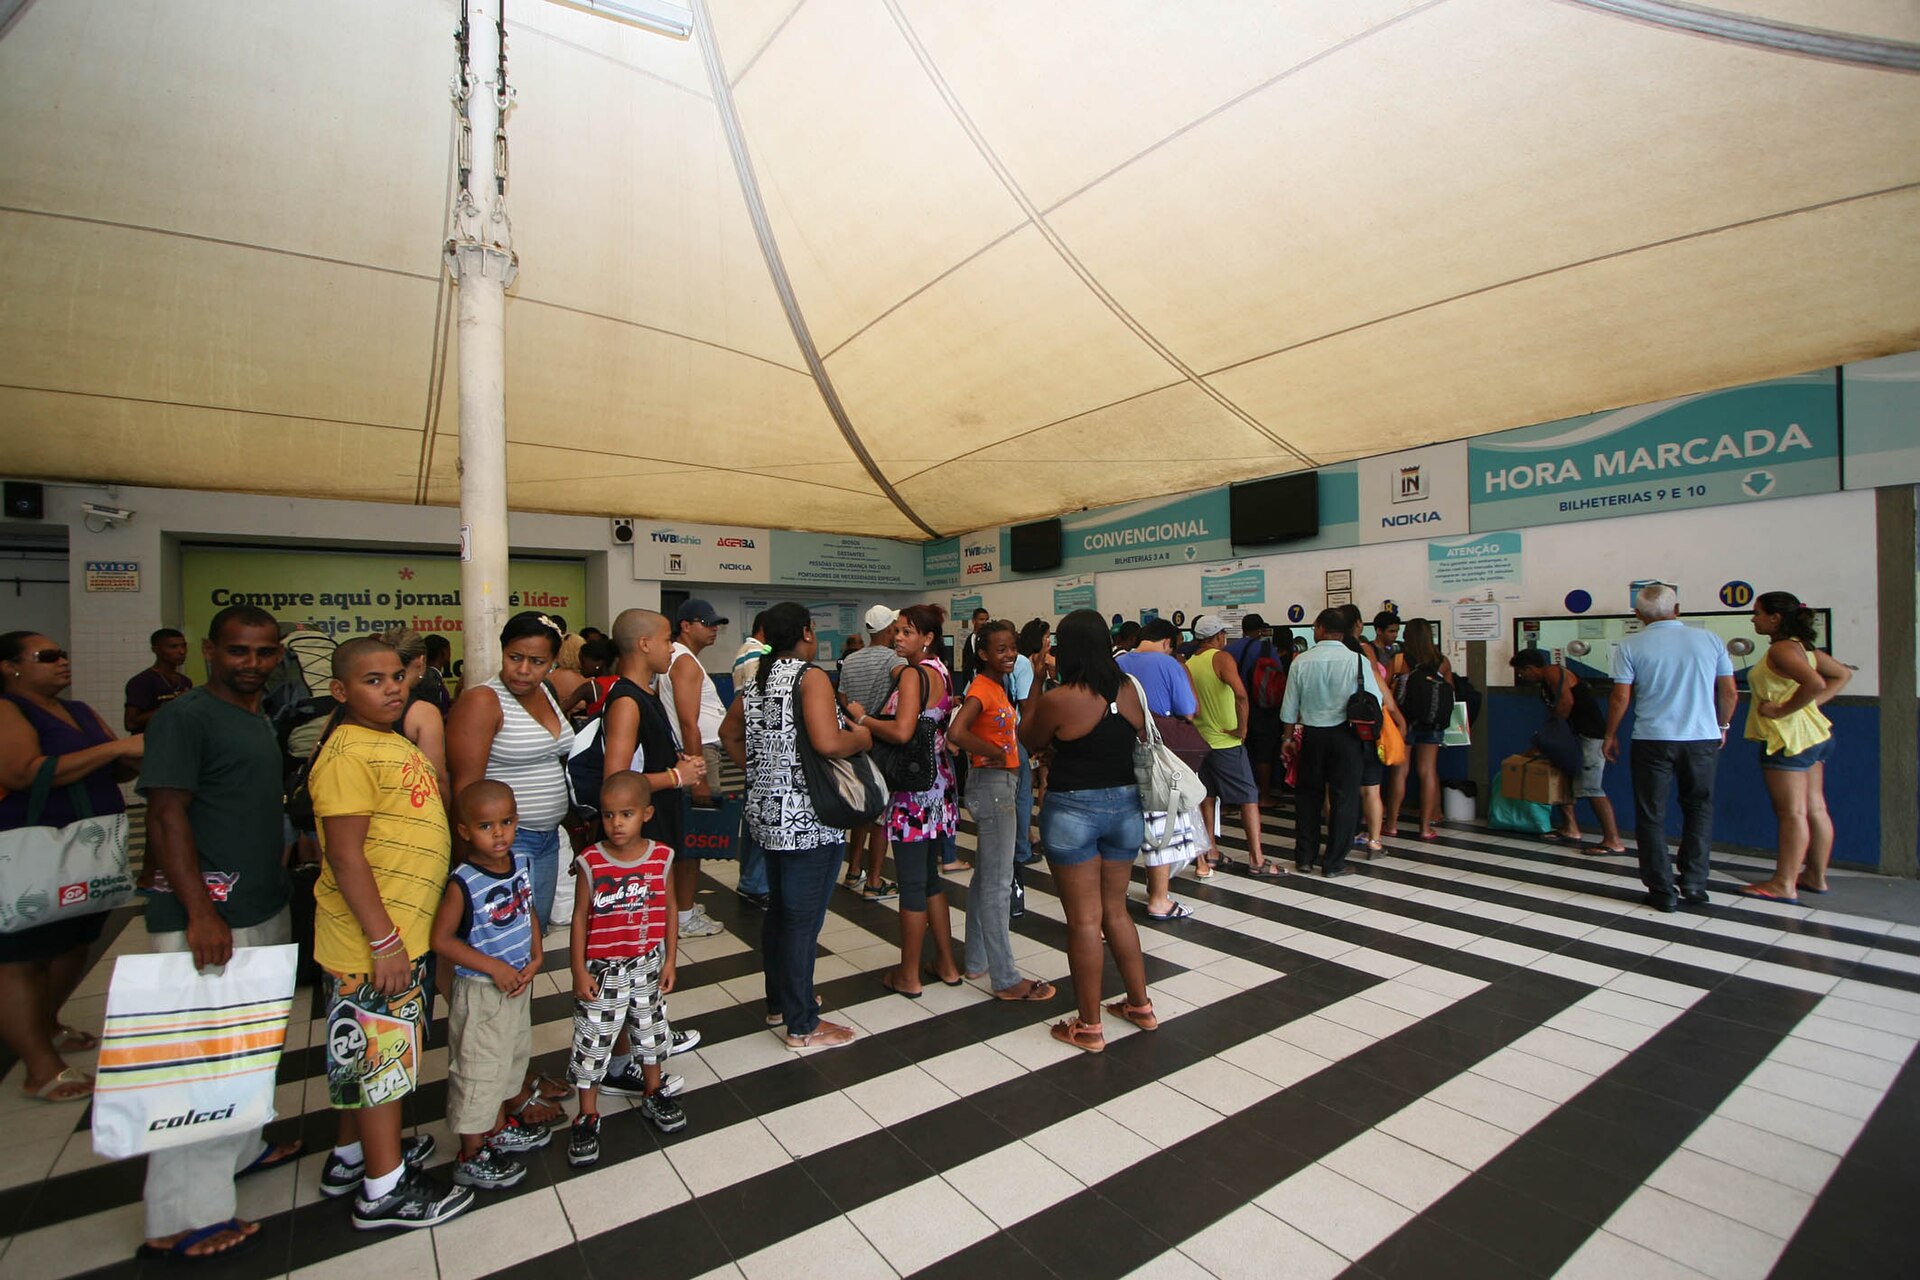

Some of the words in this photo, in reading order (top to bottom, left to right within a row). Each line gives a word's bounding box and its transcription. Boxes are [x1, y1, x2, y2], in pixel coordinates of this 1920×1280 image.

[1485, 459, 1582, 493] HORA
[1593, 423, 1813, 478] MARCADA
[1559, 491, 1652, 512] BILHETERIAS
[1657, 489, 1666, 501] 9
[1672, 488, 1681, 499] E
[1687, 485, 1706, 498] 10
[1382, 511, 1442, 528] NOKIA
[1084, 519, 1209, 550] CONVENCIONAL
[1446, 543, 1500, 557] ATENÇÃO
[89, 563, 136, 571] AVISO
[719, 563, 752, 571] NOKIA
[1114, 553, 1152, 565] BILHETERIAS
[211, 588, 314, 610] Compre
[319, 588, 372, 610] aqui
[376, 592, 390, 606] o
[394, 589, 461, 610] jornal
[509, 590, 519, 607] é
[523, 590, 569, 608] líder
[1722, 588, 1748, 604] 10
[1174, 612, 1181, 625] 6
[1293, 606, 1300, 619] 7
[356, 616, 406, 633] bem
[412, 615, 463, 632] infor
[684, 833, 730, 849] OSCH
[149, 1103, 236, 1131] colcci
